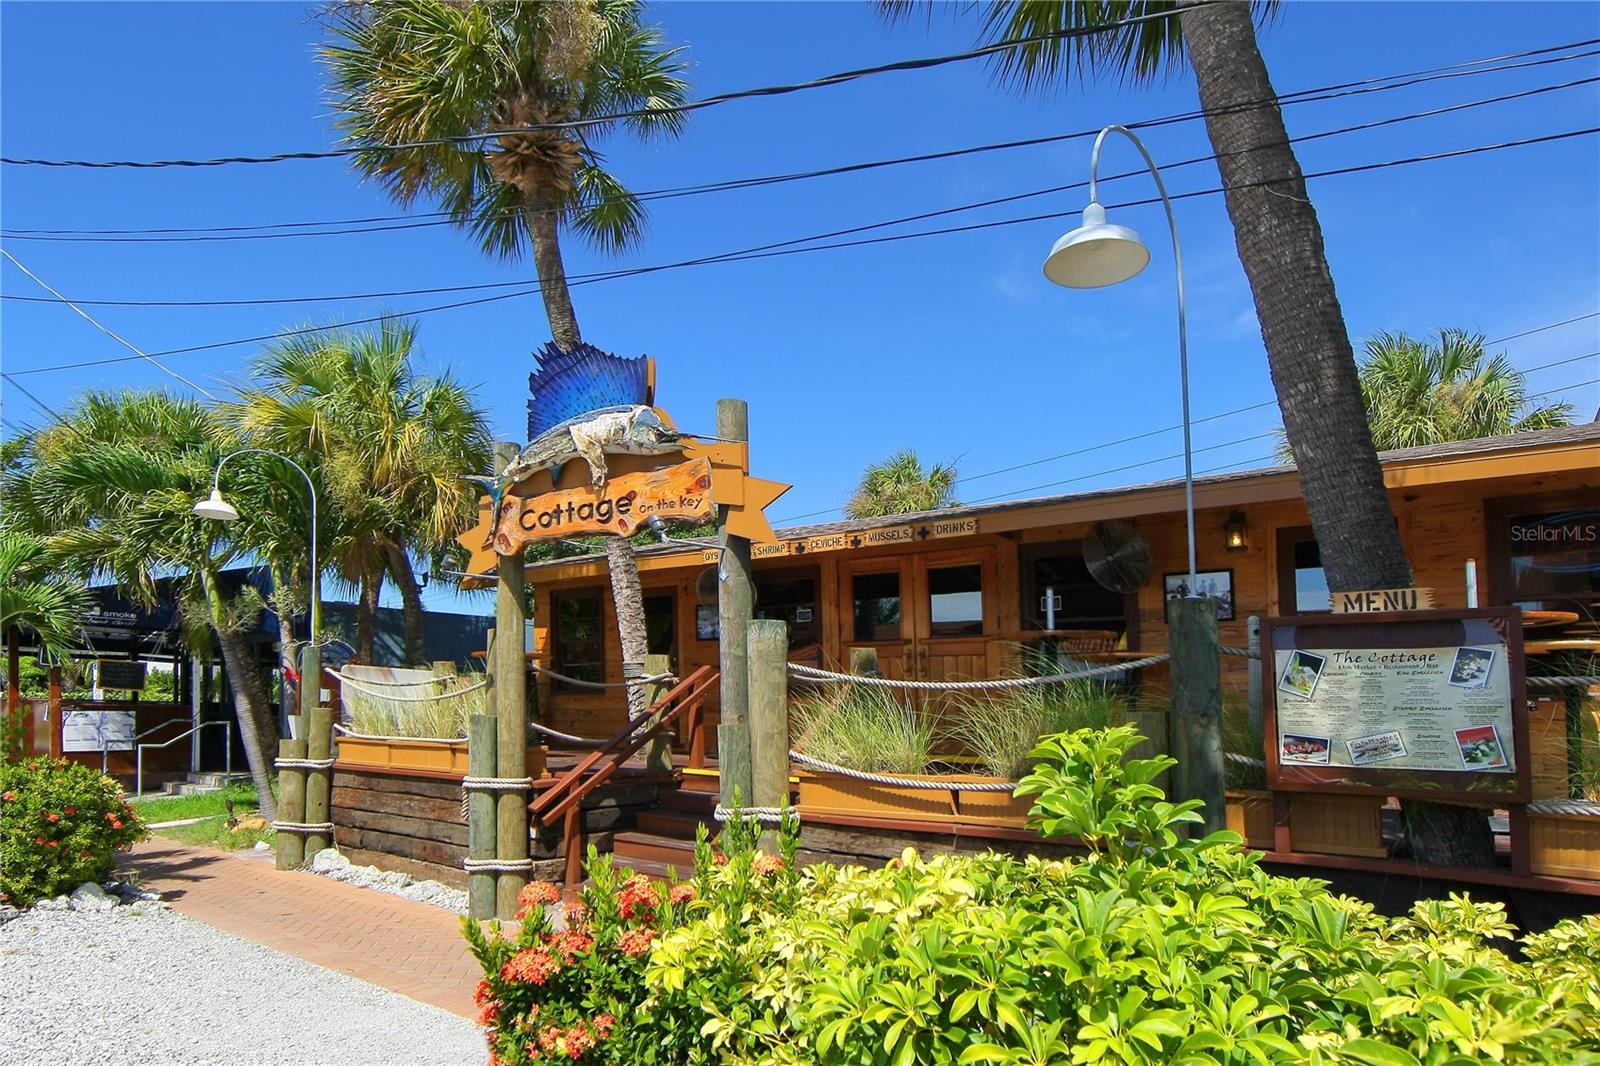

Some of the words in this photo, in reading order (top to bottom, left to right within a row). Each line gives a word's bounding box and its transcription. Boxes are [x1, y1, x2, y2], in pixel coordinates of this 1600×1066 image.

[519, 496, 633, 532] Cottage
[656, 498, 676, 510] the
[757, 544, 786, 556] SHRIMP
[810, 537, 843, 550] CEVICHE
[867, 529, 909, 543] MUSSELS
[936, 521, 974, 535] DRINKS
[1343, 589, 1417, 613] MENU
[103, 611, 137, 619] smoke
[1333, 650, 1362, 664] The
[1368, 651, 1437, 669] Cottage
